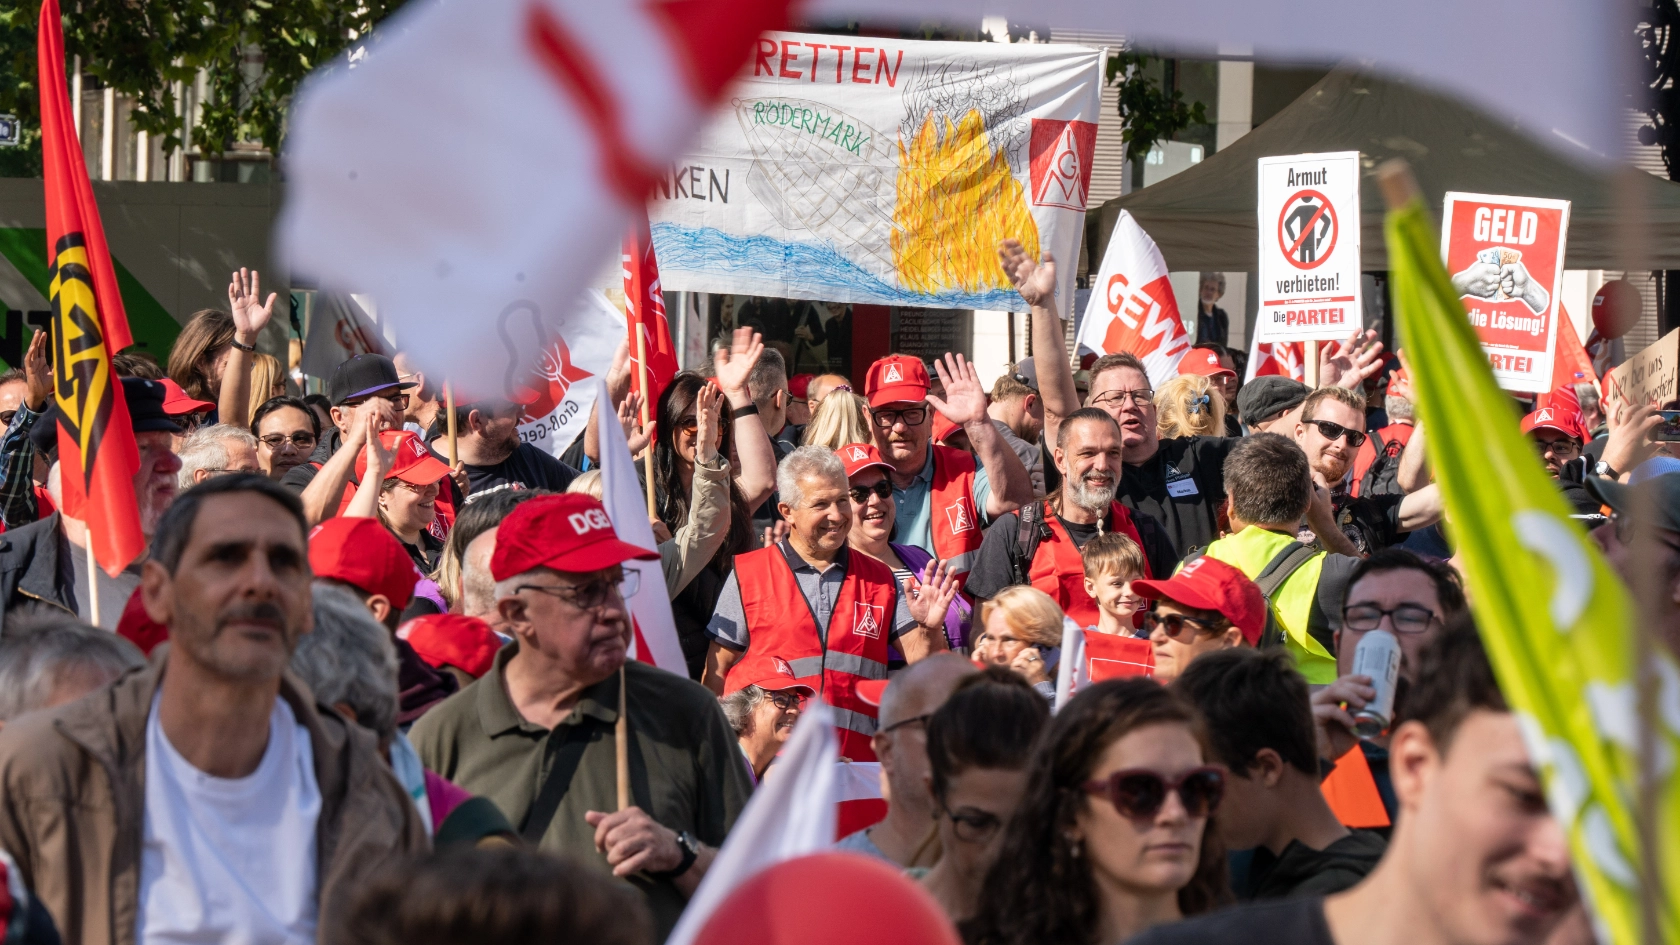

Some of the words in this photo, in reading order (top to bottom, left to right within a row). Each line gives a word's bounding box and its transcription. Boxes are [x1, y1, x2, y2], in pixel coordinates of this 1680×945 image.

[754, 38, 904, 88] RETTEN
[753, 100, 870, 156] RÖDERMARK
[653, 161, 730, 204] NKEN
[1287, 166, 1328, 187] Armut
[1473, 206, 1538, 246] GELD
[1276, 272, 1340, 294] verbieten!
[1107, 273, 1190, 358] GEW
[1273, 311, 1286, 323] Die
[1286, 307, 1344, 327] PARTEI
[1490, 310, 1546, 336] Lösung!
[1490, 353, 1533, 373] RTEI
[567, 508, 611, 536] DGB
